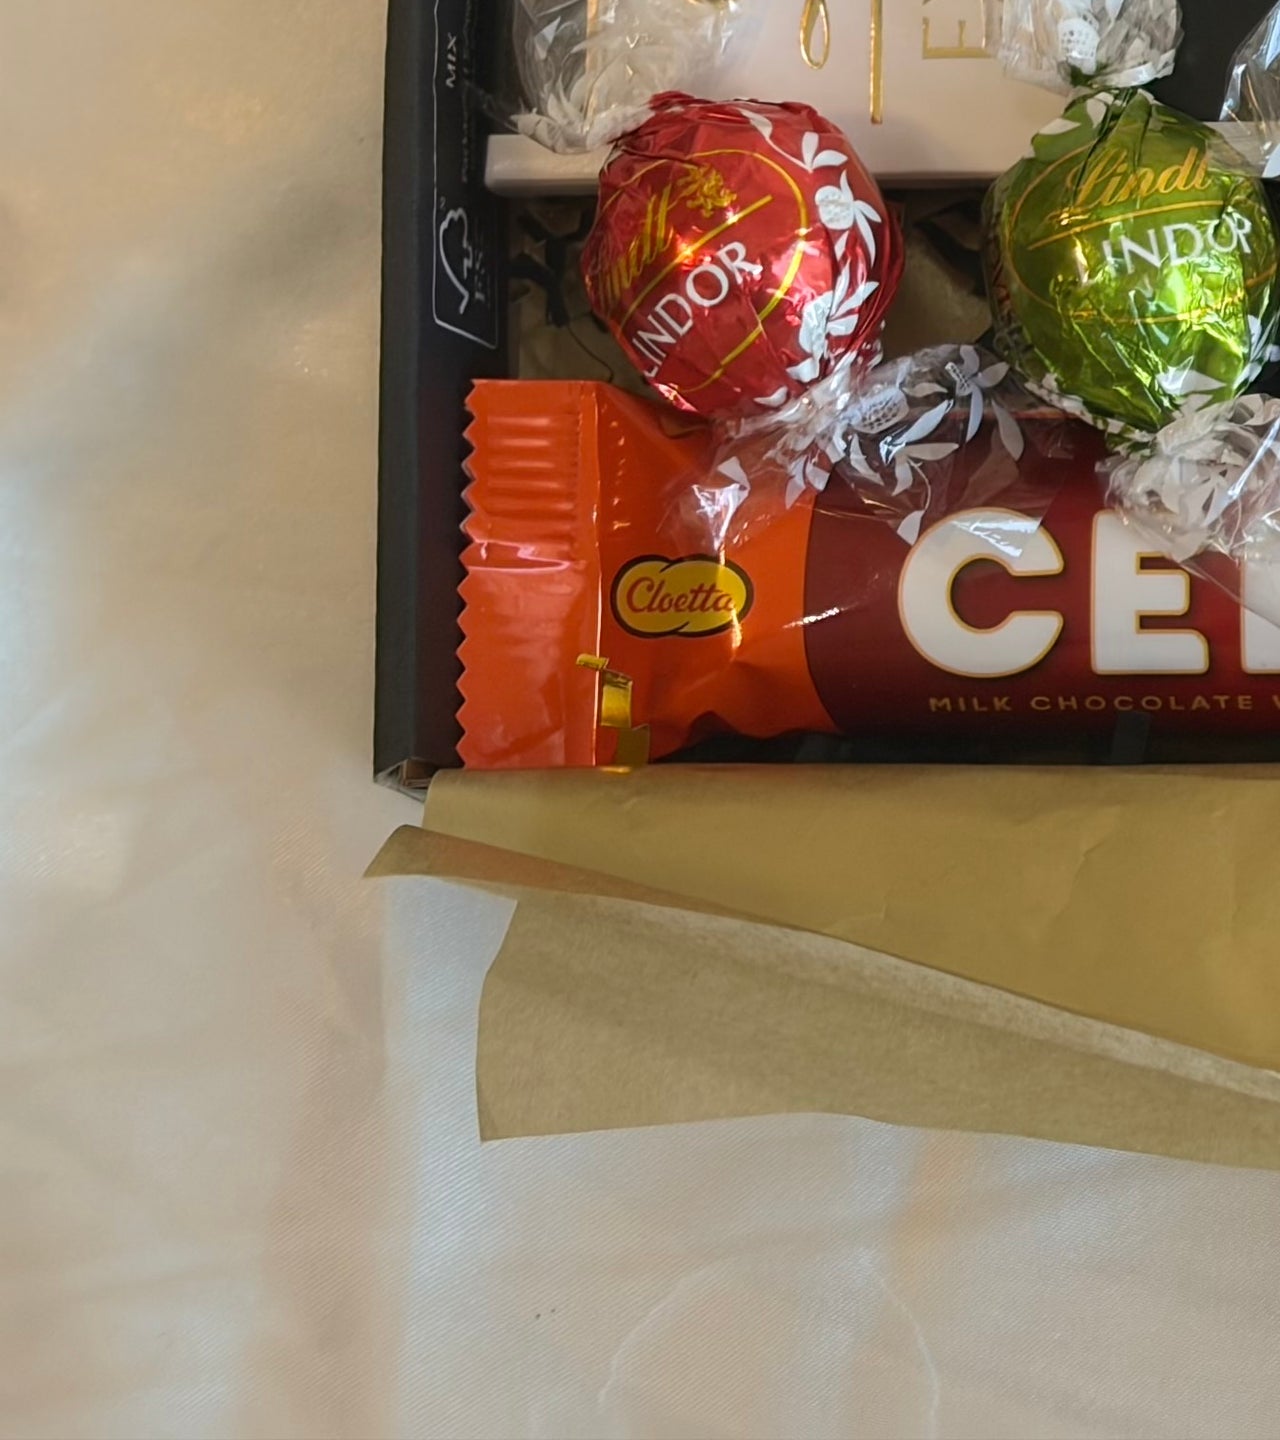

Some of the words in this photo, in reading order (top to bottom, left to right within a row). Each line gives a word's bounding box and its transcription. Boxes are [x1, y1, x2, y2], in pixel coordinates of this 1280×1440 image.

[444, 31, 459, 89] MIX
[626, 575, 737, 614] Cloetta
[929, 695, 1013, 713] MILK
[1029, 695, 1255, 713] CHOCOLATE
